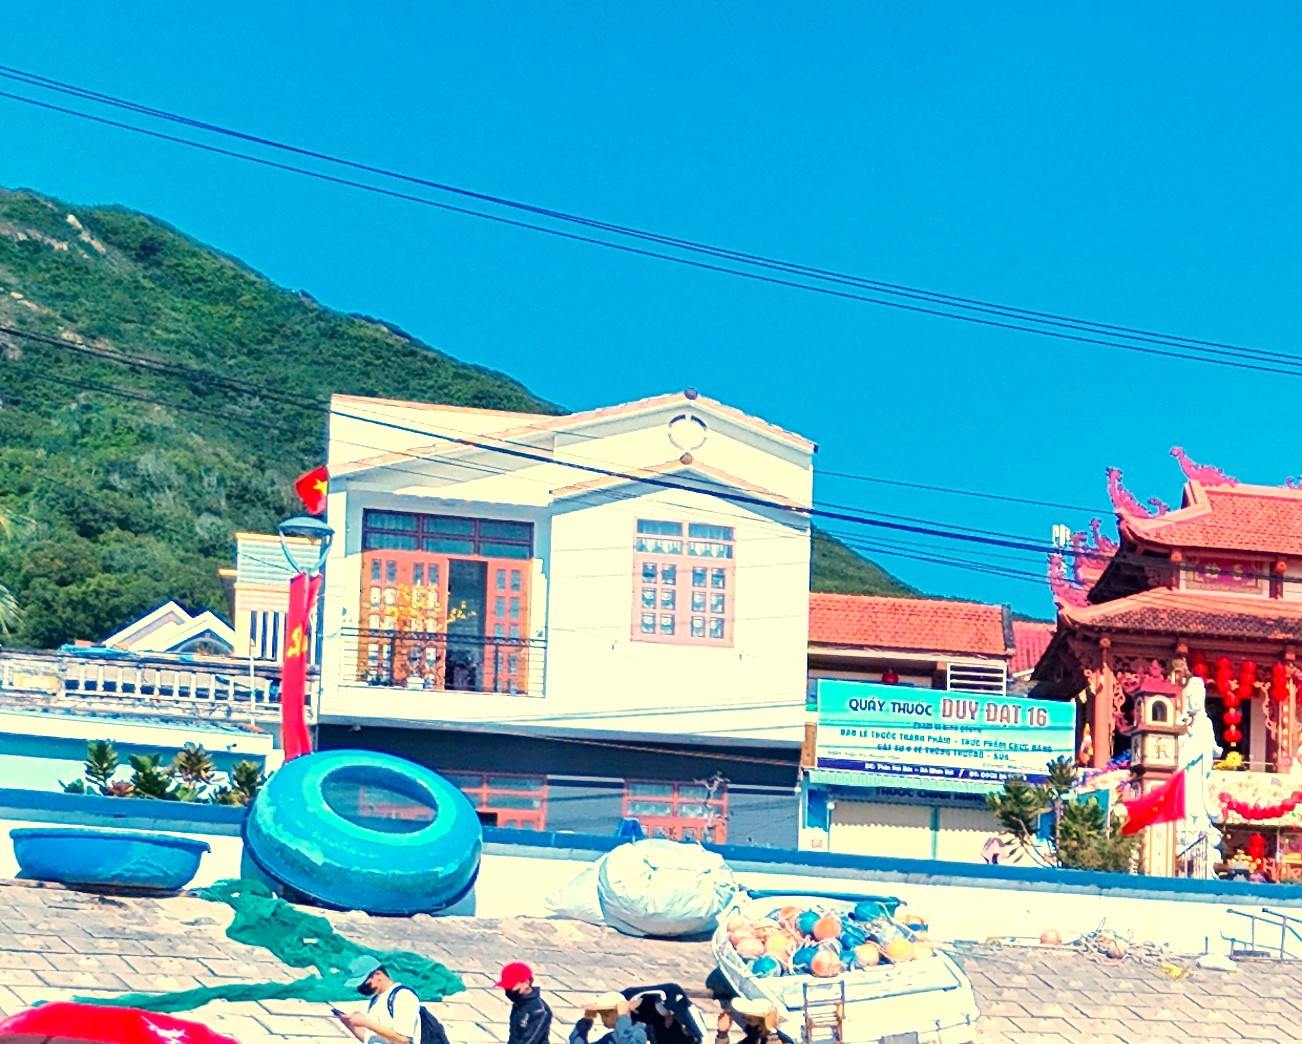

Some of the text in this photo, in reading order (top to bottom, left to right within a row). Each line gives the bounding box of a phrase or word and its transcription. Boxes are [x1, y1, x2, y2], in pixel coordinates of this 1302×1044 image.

[942, 698, 980, 720] DUY
[985, 702, 1022, 727] ĐẠT
[1027, 707, 1048, 727] 16
